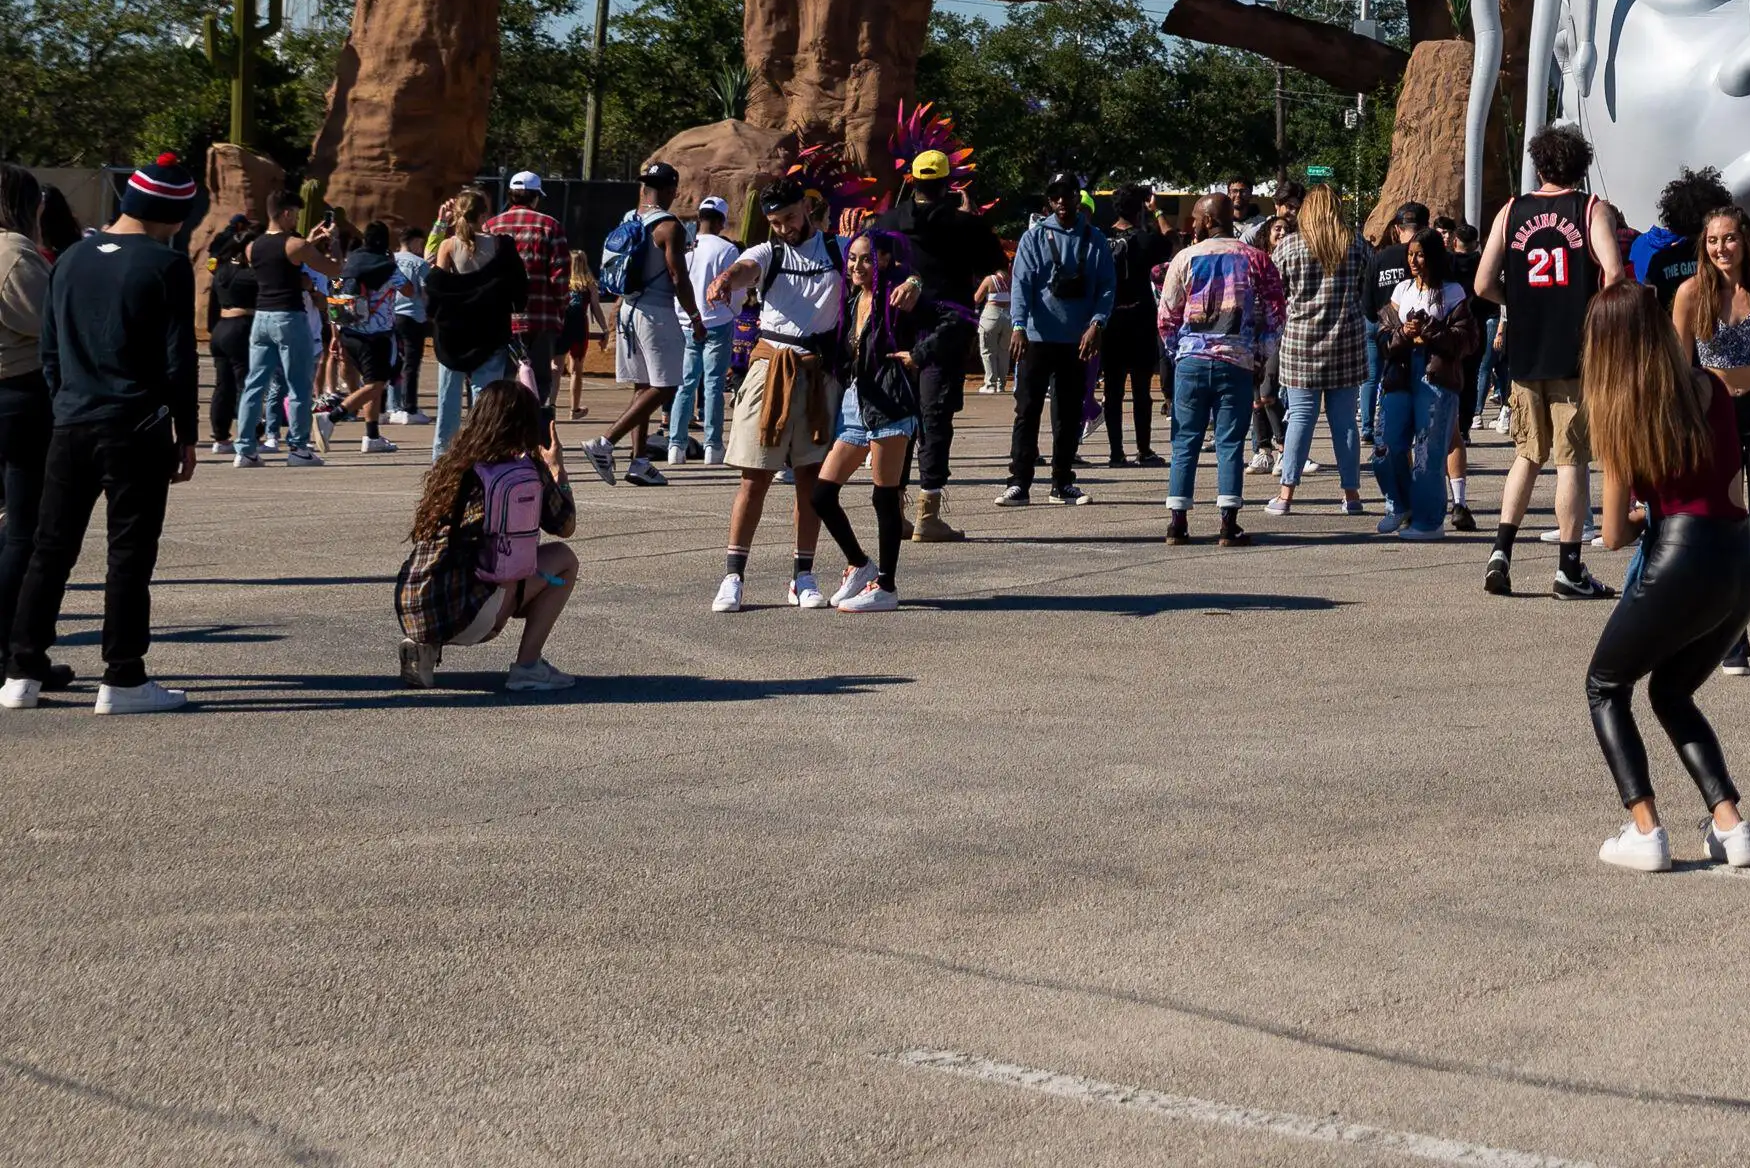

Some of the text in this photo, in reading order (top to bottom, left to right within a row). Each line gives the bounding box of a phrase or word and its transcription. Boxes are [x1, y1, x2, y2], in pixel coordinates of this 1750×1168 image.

[1511, 213, 1583, 251] ROLLING LOUD
[1528, 247, 1568, 287] 21
[1663, 263, 1679, 280] THE
